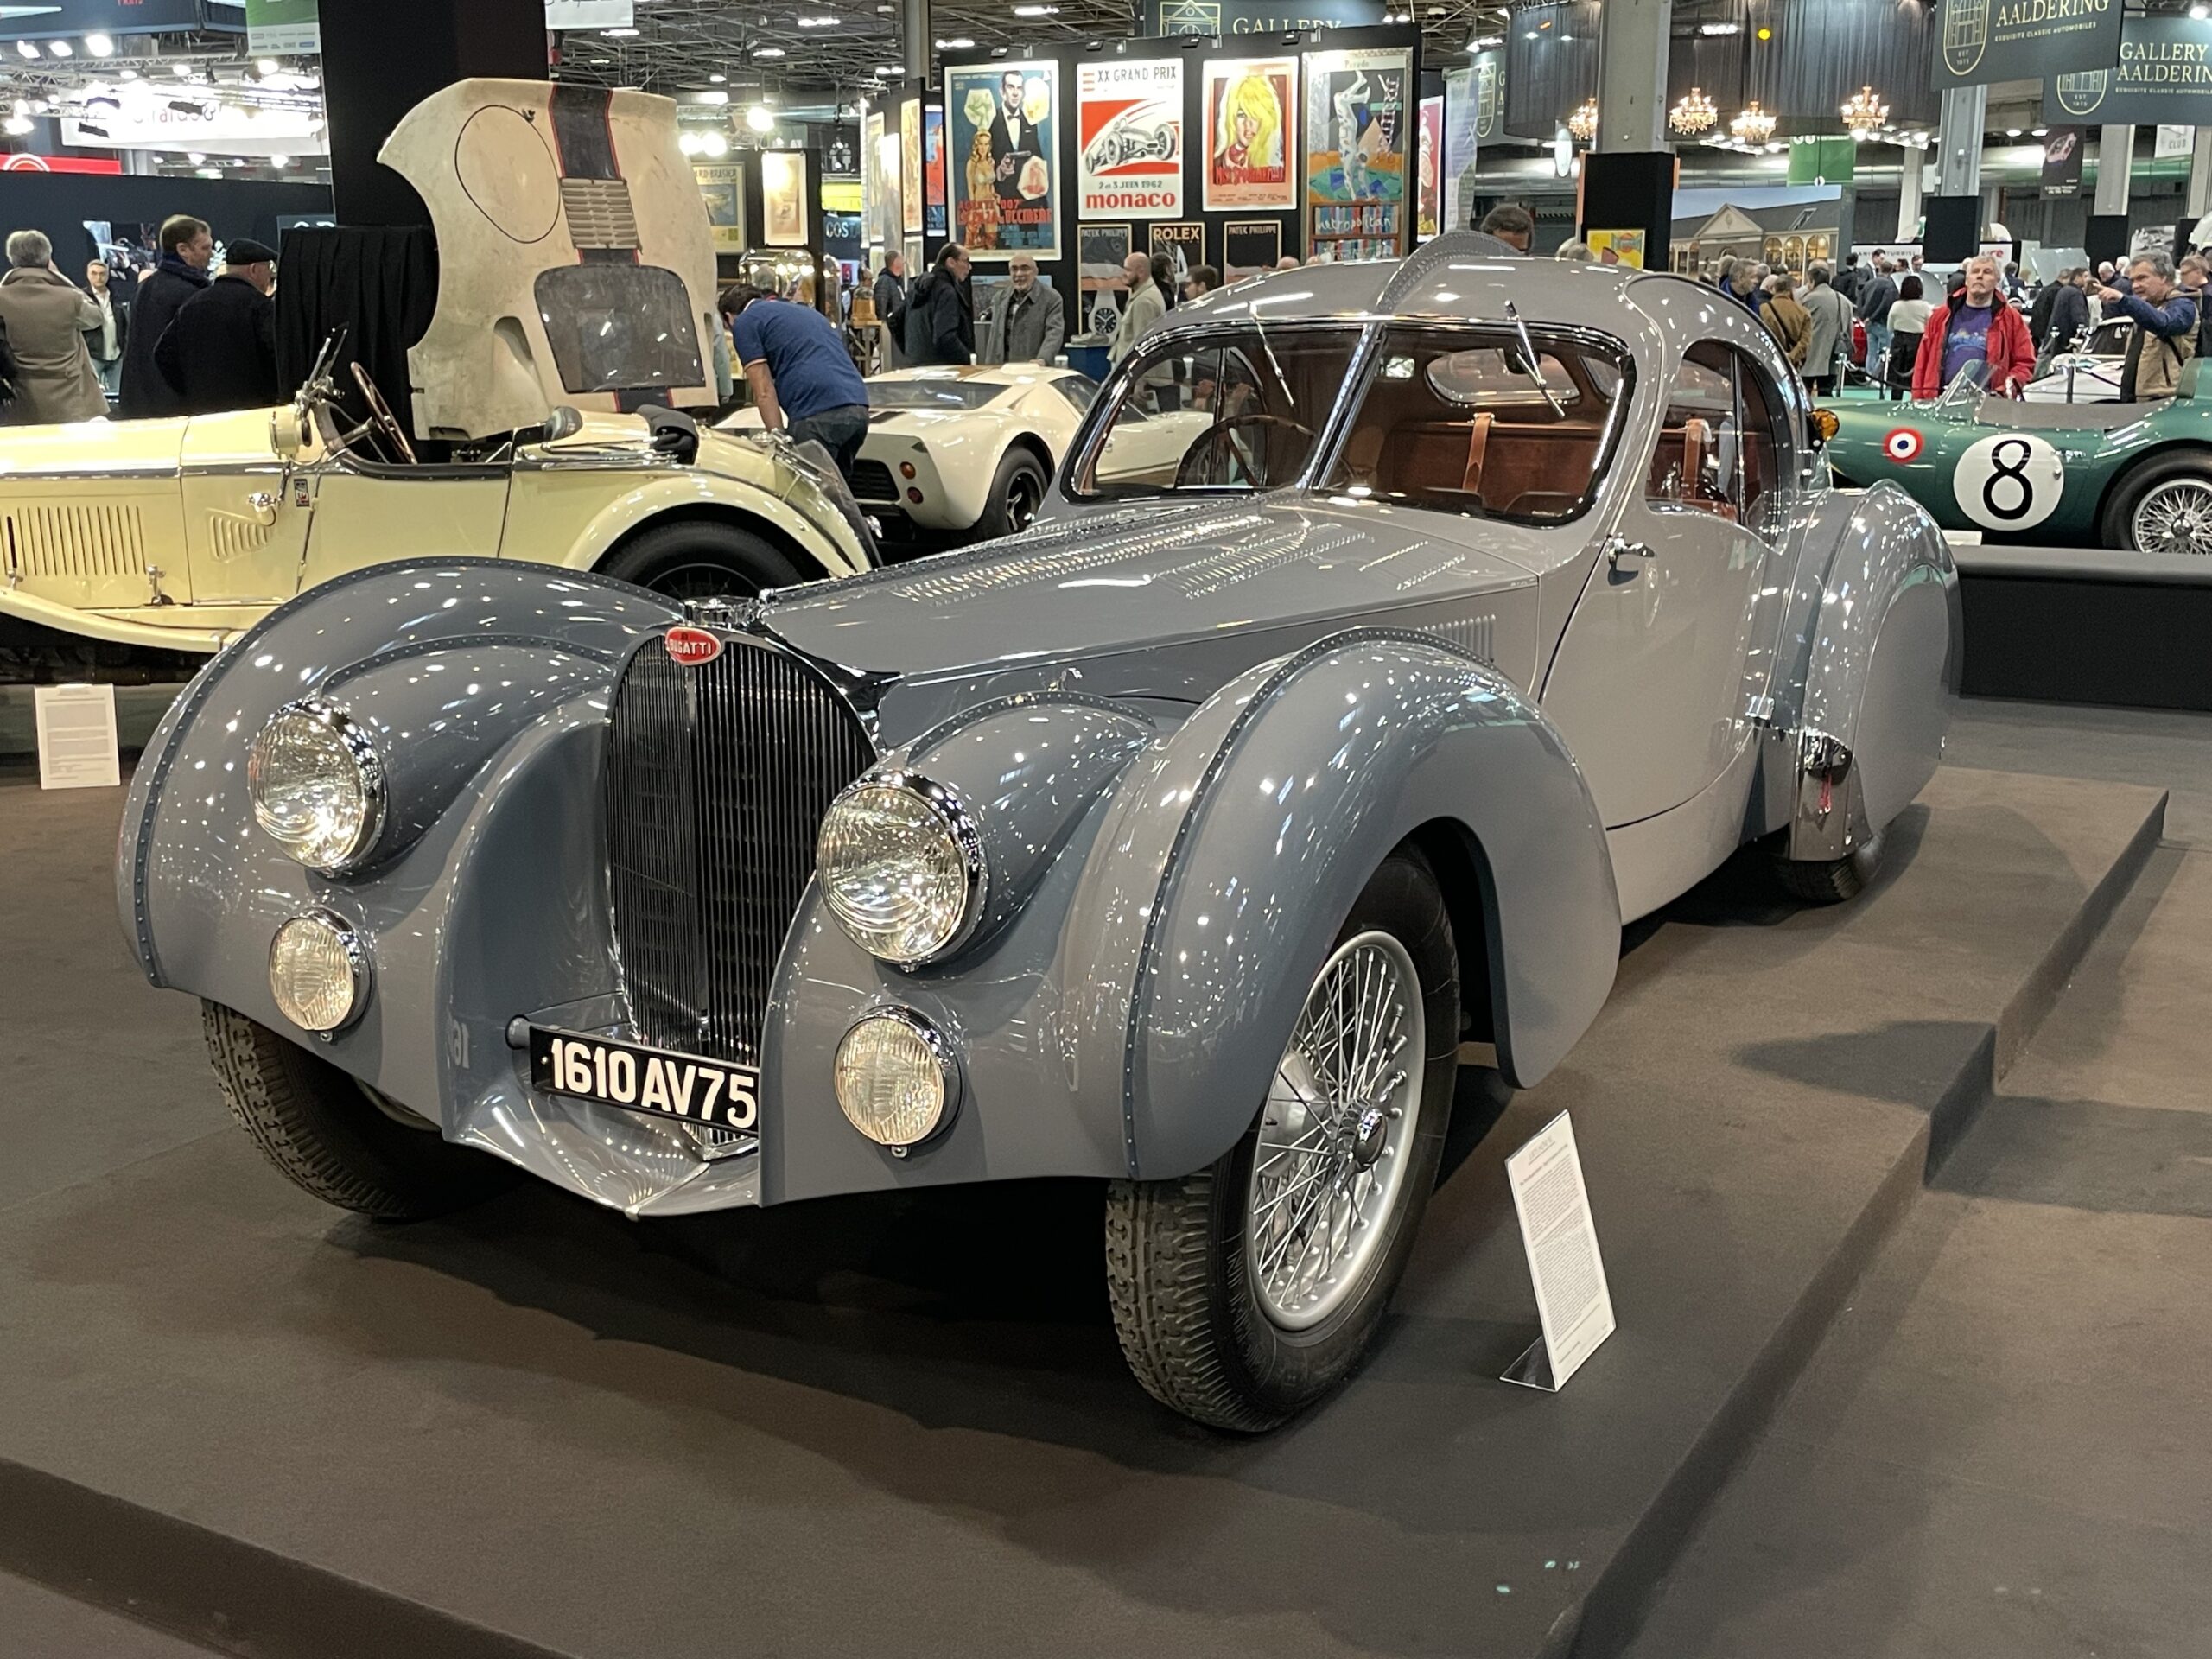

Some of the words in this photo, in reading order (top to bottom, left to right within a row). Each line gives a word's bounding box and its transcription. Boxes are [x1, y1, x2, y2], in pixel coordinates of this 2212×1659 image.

[1996, 0, 2109, 28] AALDERING
[2026, 28, 2051, 38] CLASSIC
[2120, 42, 2209, 61] GALLERY
[1097, 70, 1110, 83] XX
[1113, 68, 1148, 82] GRAND
[1154, 66, 1176, 79] PRIX
[1120, 180, 1140, 188] JUIN
[1141, 179, 1163, 189] 1962
[1086, 192, 1176, 208] monaco
[1153, 226, 1200, 241] ROLEX
[1228, 226, 1248, 236] PATEK
[1983, 439, 2032, 521] 8
[669, 639, 712, 655] BUGATTI
